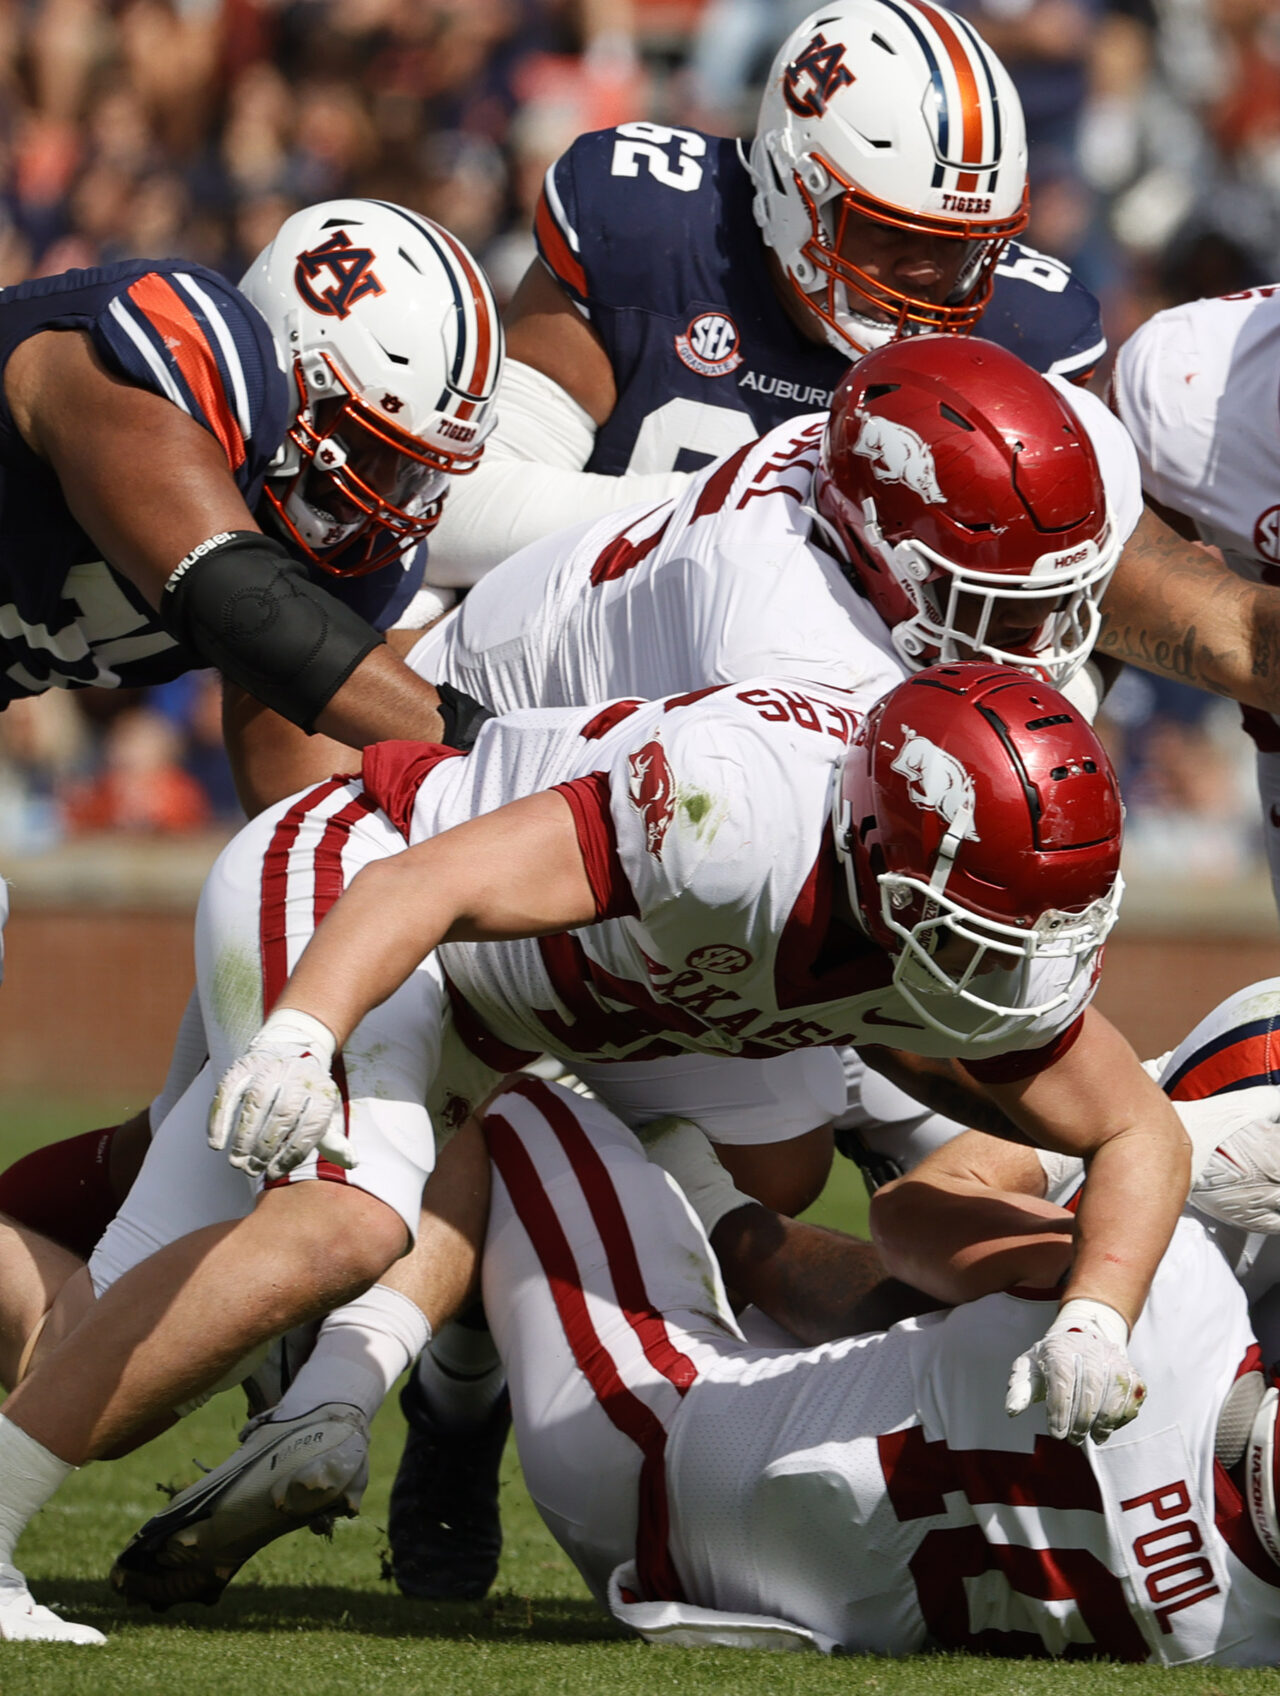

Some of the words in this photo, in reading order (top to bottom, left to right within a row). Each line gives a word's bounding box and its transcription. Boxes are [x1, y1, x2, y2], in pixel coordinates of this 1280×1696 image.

[611, 121, 706, 192] 62
[942, 194, 992, 214] TIGERS
[691, 316, 737, 361] SEC
[679, 346, 732, 375] GRADUATE
[436, 419, 477, 443] TIGERS
[1054, 549, 1089, 569] HOGS
[877, 1425, 1152, 1664] 10
[1120, 1479, 1221, 1635] POOL
